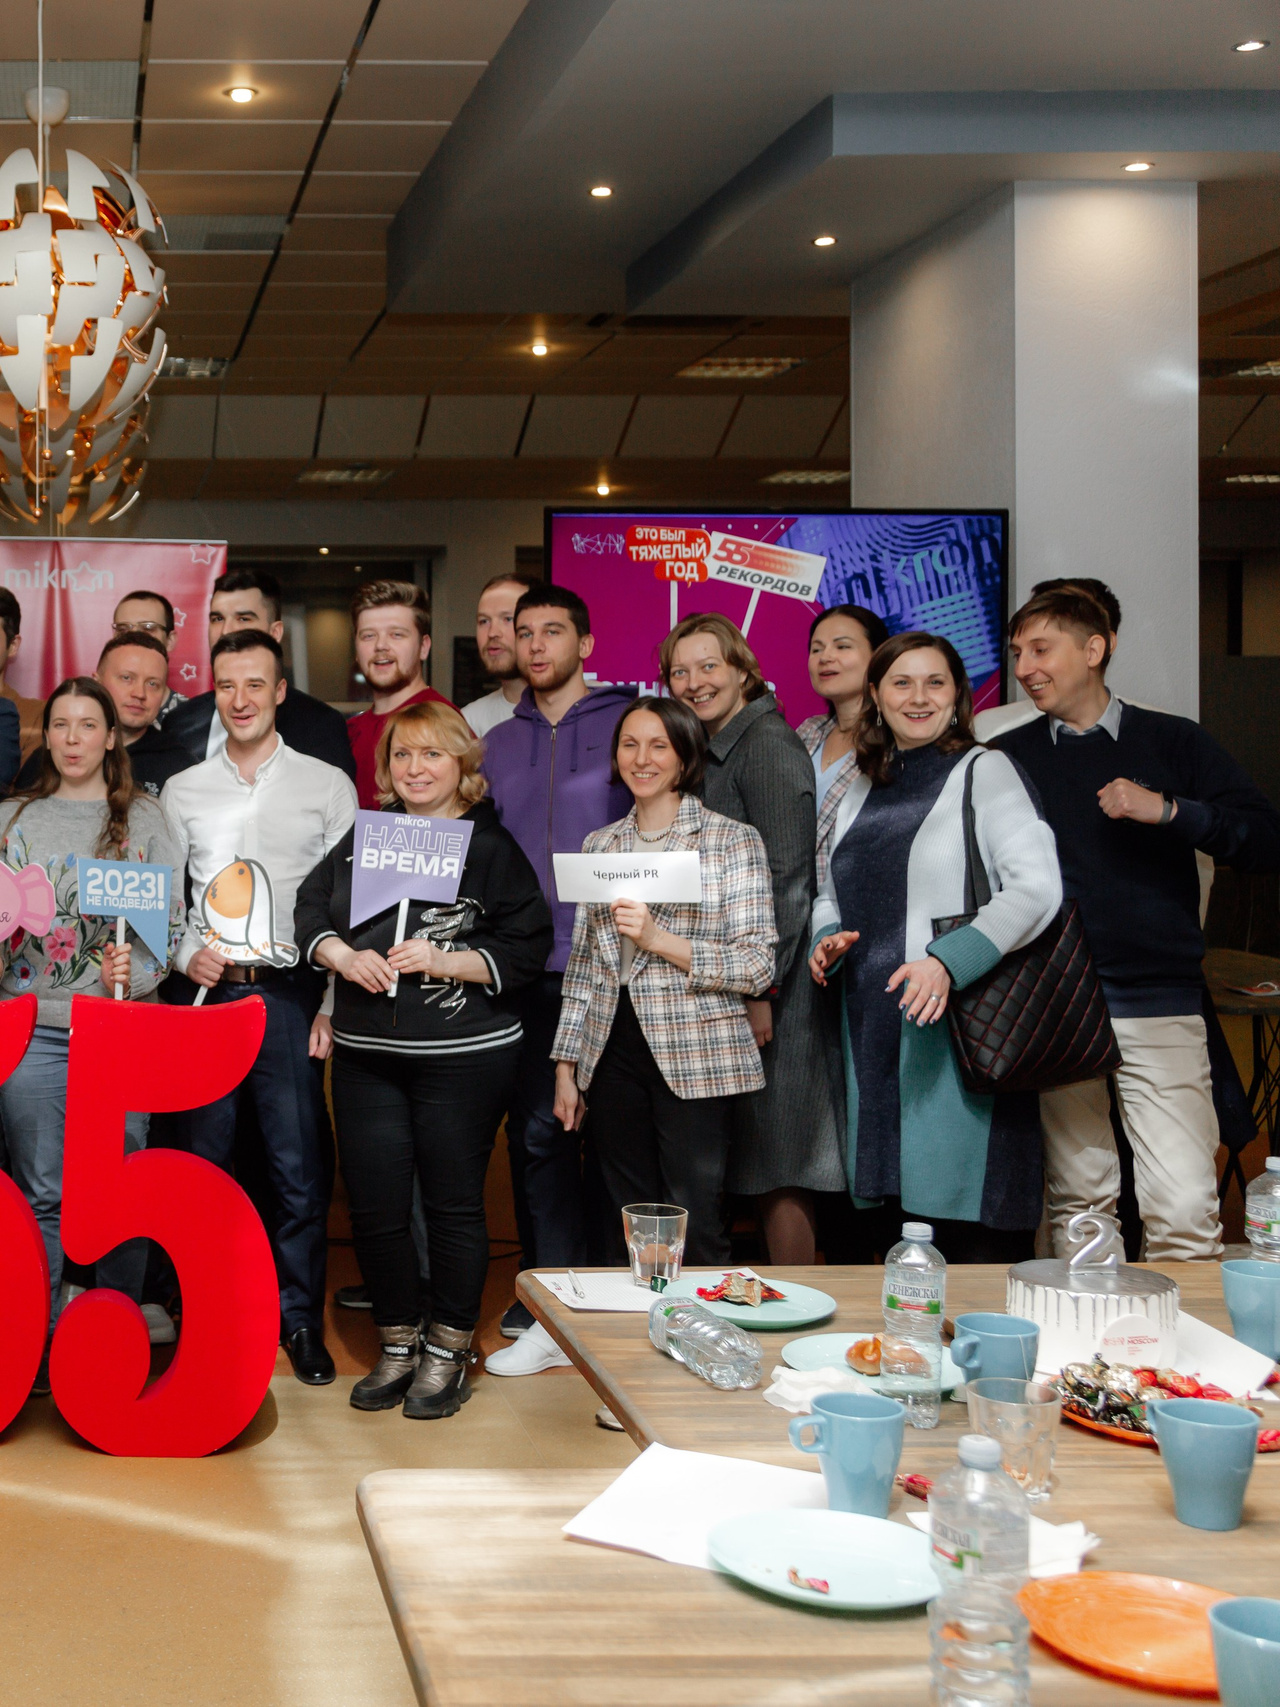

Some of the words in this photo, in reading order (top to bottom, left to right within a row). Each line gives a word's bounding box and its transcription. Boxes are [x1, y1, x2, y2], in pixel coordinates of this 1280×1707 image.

[635, 527, 658, 540] ЭТО
[660, 529, 686, 542] БЫЛ
[629, 537, 707, 561] ТЯЖЕЛЫЙ
[665, 561, 699, 582] ГОД
[716, 565, 812, 596] РЕКОРДОВ
[394, 815, 431, 828] mikron
[363, 824, 464, 858] НАШЕ
[360, 847, 460, 879] ВРЕМЯ
[593, 869, 641, 881] Черный
[643, 869, 659, 879] PR
[86, 895, 102, 906] НЕ
[1067, 1209, 1118, 1275] 2
[888, 1283, 939, 1299] СЕНЕЖСКАЯ
[1127, 1337, 1158, 1345] MOSCOW
